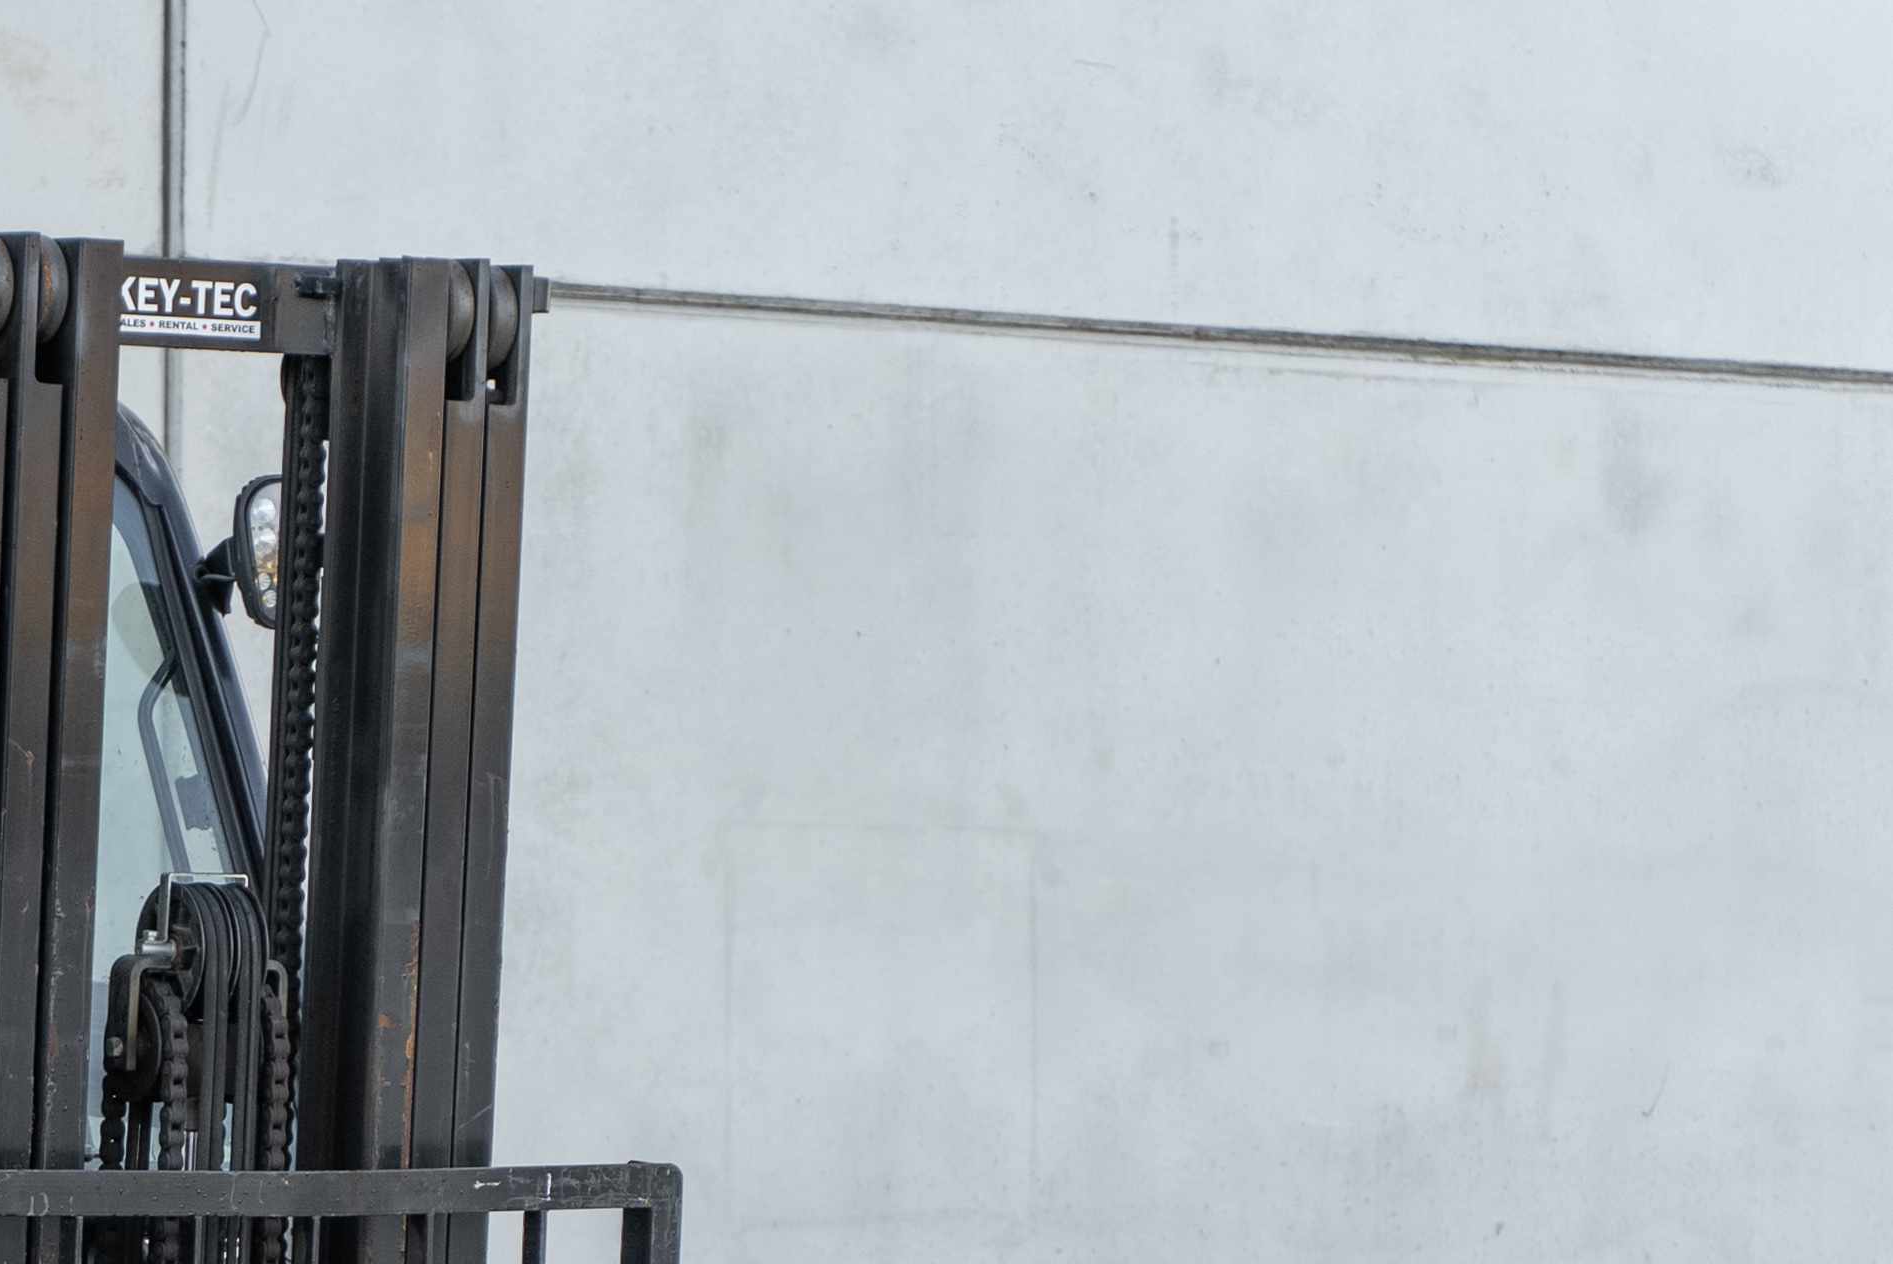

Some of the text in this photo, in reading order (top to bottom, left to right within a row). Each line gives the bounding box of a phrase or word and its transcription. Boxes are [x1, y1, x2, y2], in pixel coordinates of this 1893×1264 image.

[120, 319, 256, 334] ALES RENTAL SERVICE
